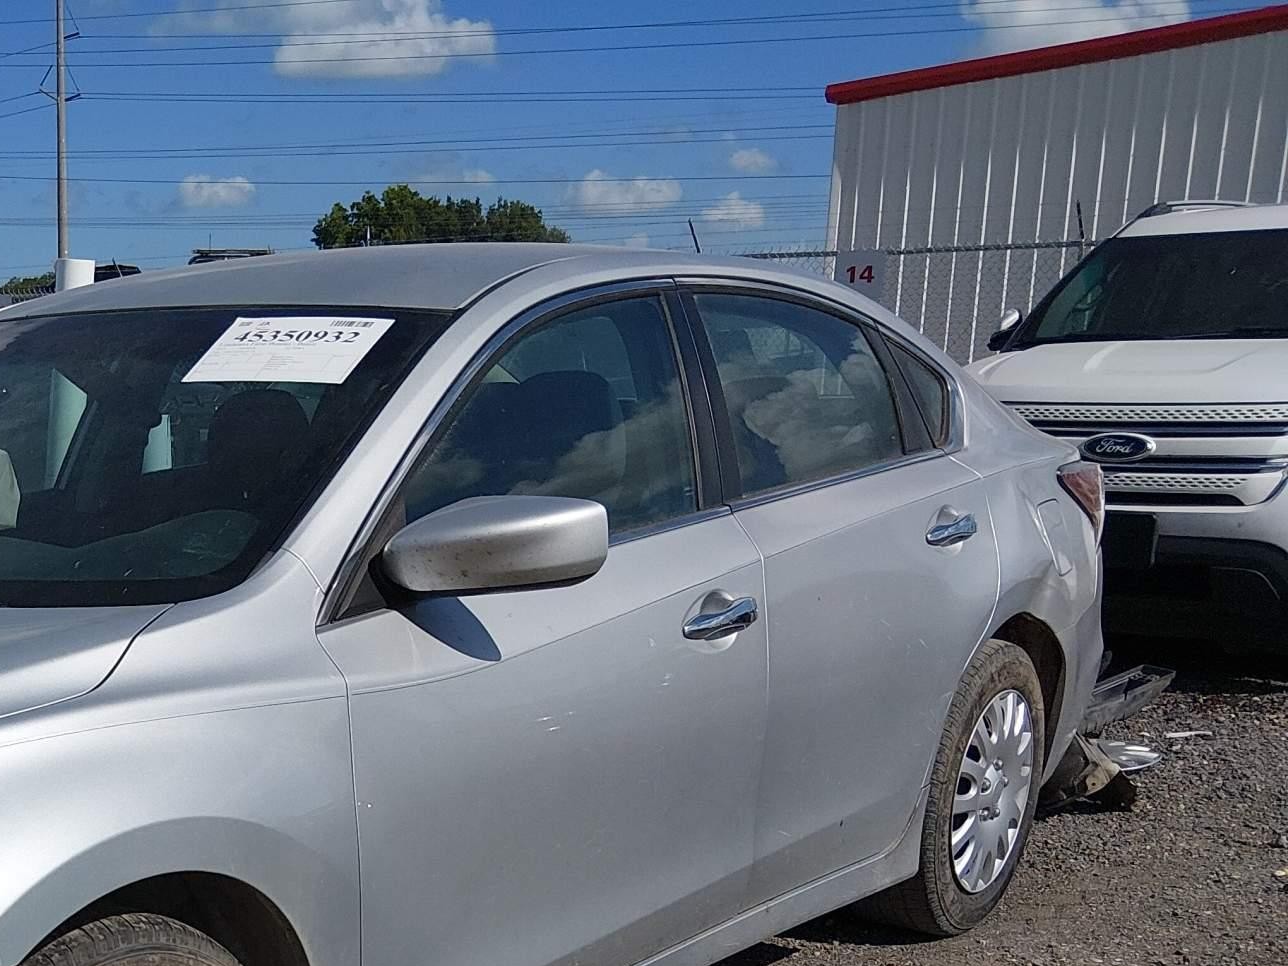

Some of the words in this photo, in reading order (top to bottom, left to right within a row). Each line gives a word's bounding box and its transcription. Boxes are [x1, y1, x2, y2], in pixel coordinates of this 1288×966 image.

[846, 265, 875, 284] 14
[234, 330, 361, 343] 45350932
[1095, 438, 1134, 453] Ford
